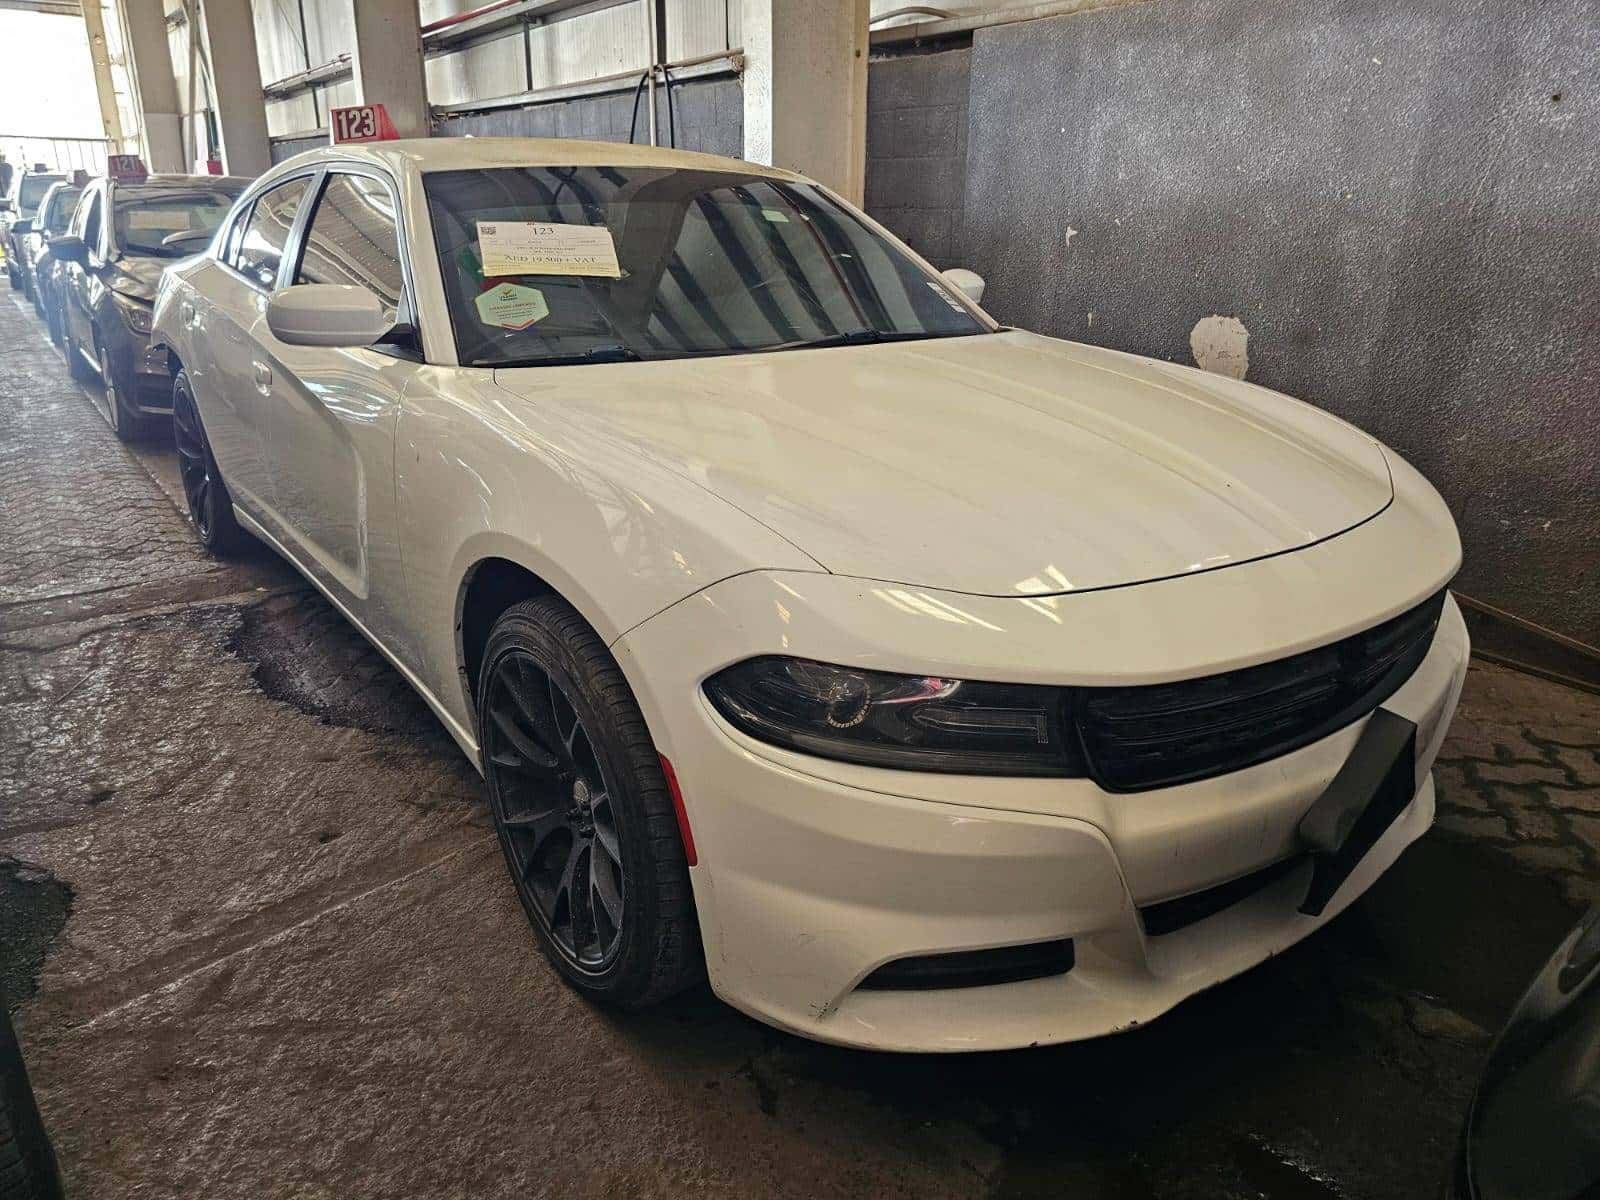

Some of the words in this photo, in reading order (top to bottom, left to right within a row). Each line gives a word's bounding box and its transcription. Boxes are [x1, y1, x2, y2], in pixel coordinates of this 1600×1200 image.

[338, 108, 376, 139] 123
[115, 156, 136, 171] 121
[533, 227, 554, 235] 123
